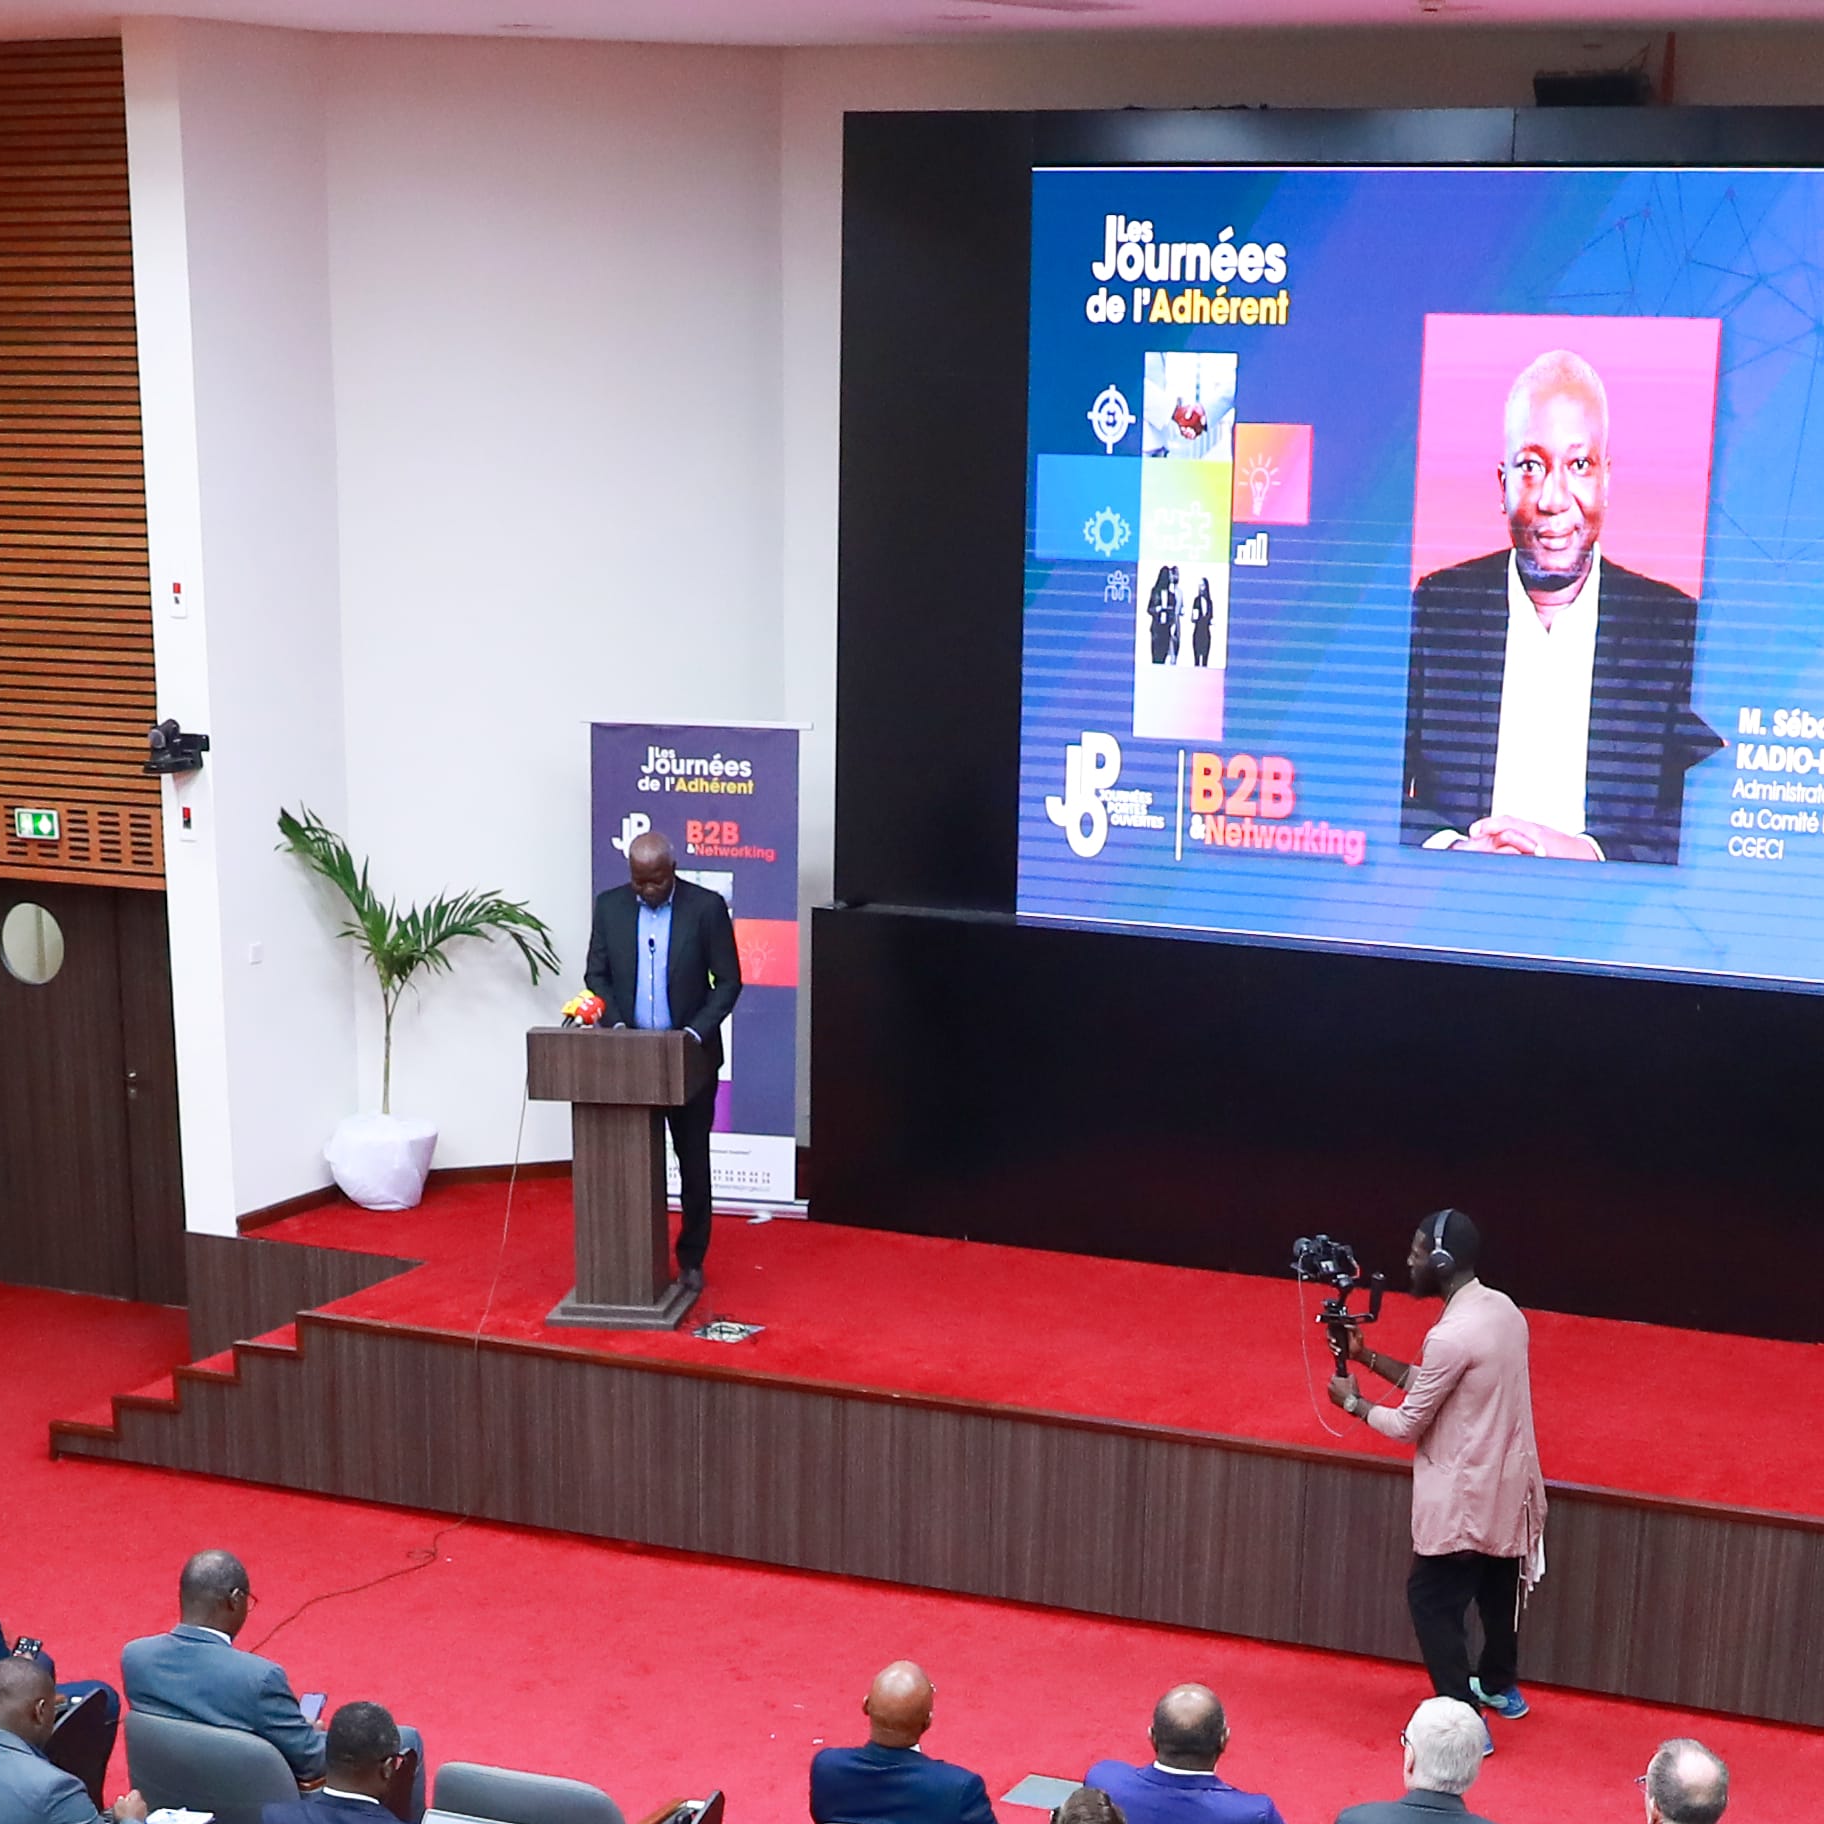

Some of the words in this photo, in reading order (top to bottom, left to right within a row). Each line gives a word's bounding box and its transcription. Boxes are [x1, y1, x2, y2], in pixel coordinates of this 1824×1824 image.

[1117, 215, 1153, 242] Les
[1092, 215, 1287, 283] Journées
[1086, 287, 1126, 323] de
[1133, 285, 1290, 325] l'Adhérent
[1738, 707, 1767, 735] M.
[641, 746, 752, 778] Journées
[655, 747, 675, 758] Les
[637, 776, 660, 791] de
[665, 776, 754, 794] l'Adhérent
[1190, 752, 1296, 819] B2B
[686, 819, 739, 845] B2B
[1730, 808, 1753, 829] du
[1757, 809, 1819, 833] Comité
[1728, 836, 1784, 860] CGECI
